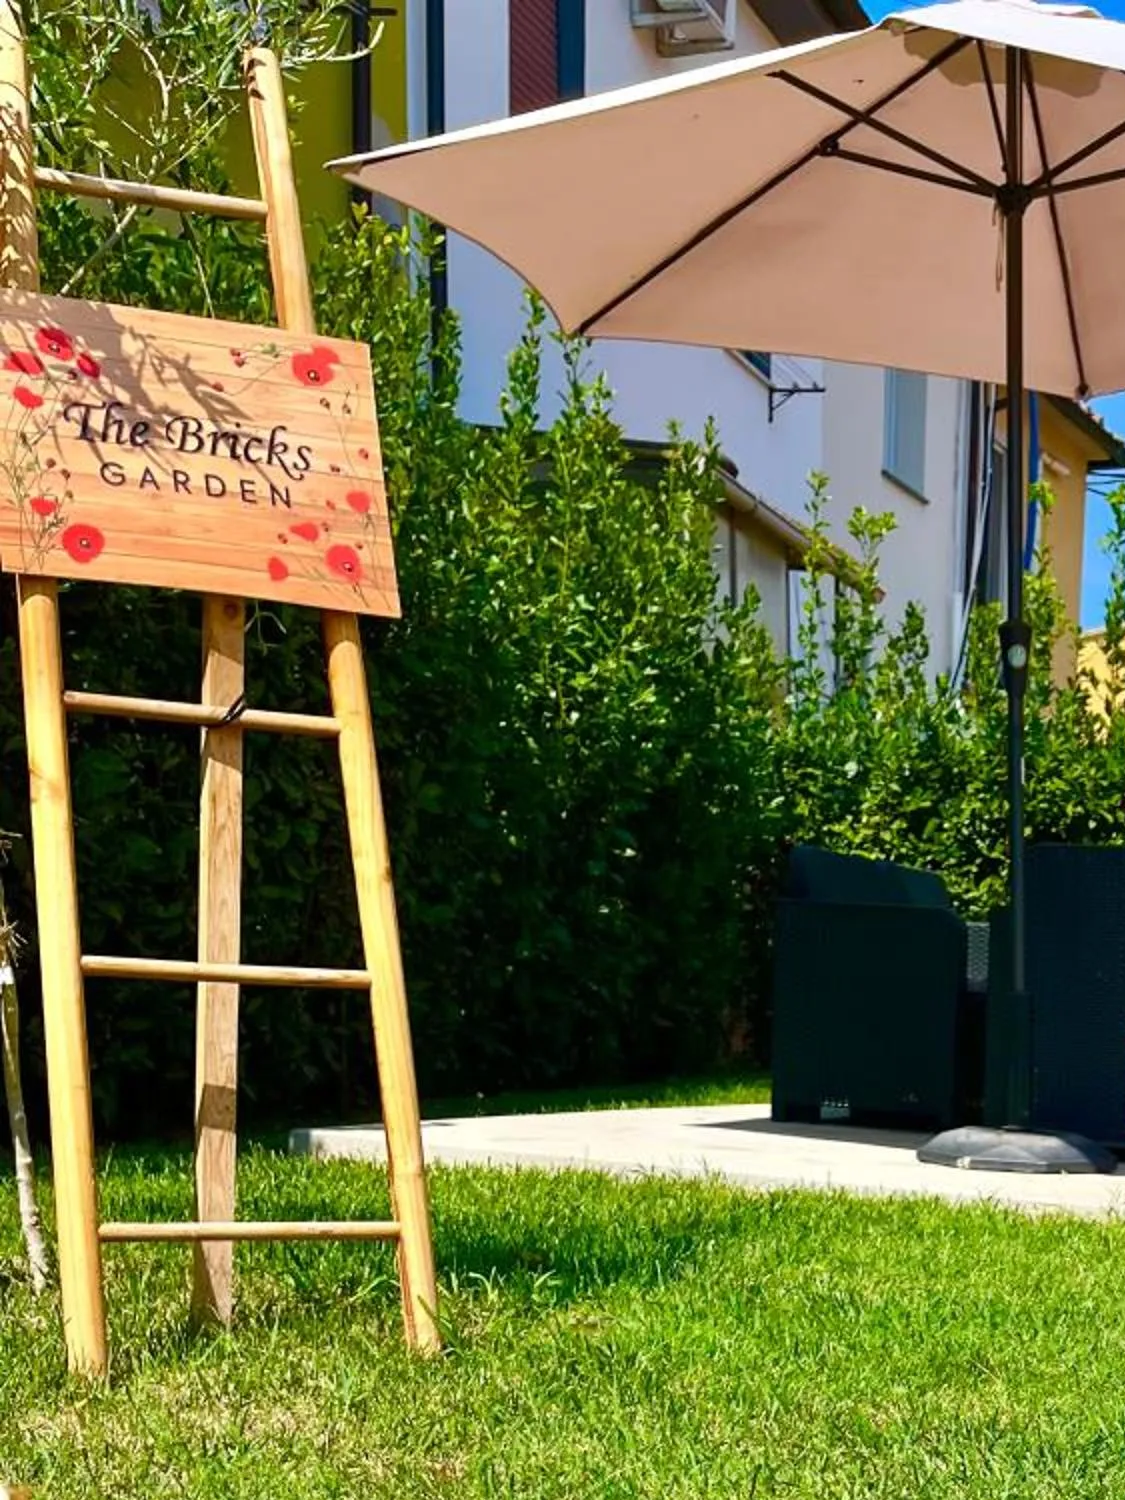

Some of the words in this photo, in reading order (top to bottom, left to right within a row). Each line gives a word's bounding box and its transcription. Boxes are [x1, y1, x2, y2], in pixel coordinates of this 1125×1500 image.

[63, 400, 151, 447] The
[165, 416, 313, 481] Bricks
[100, 462, 292, 508] GARDEN
